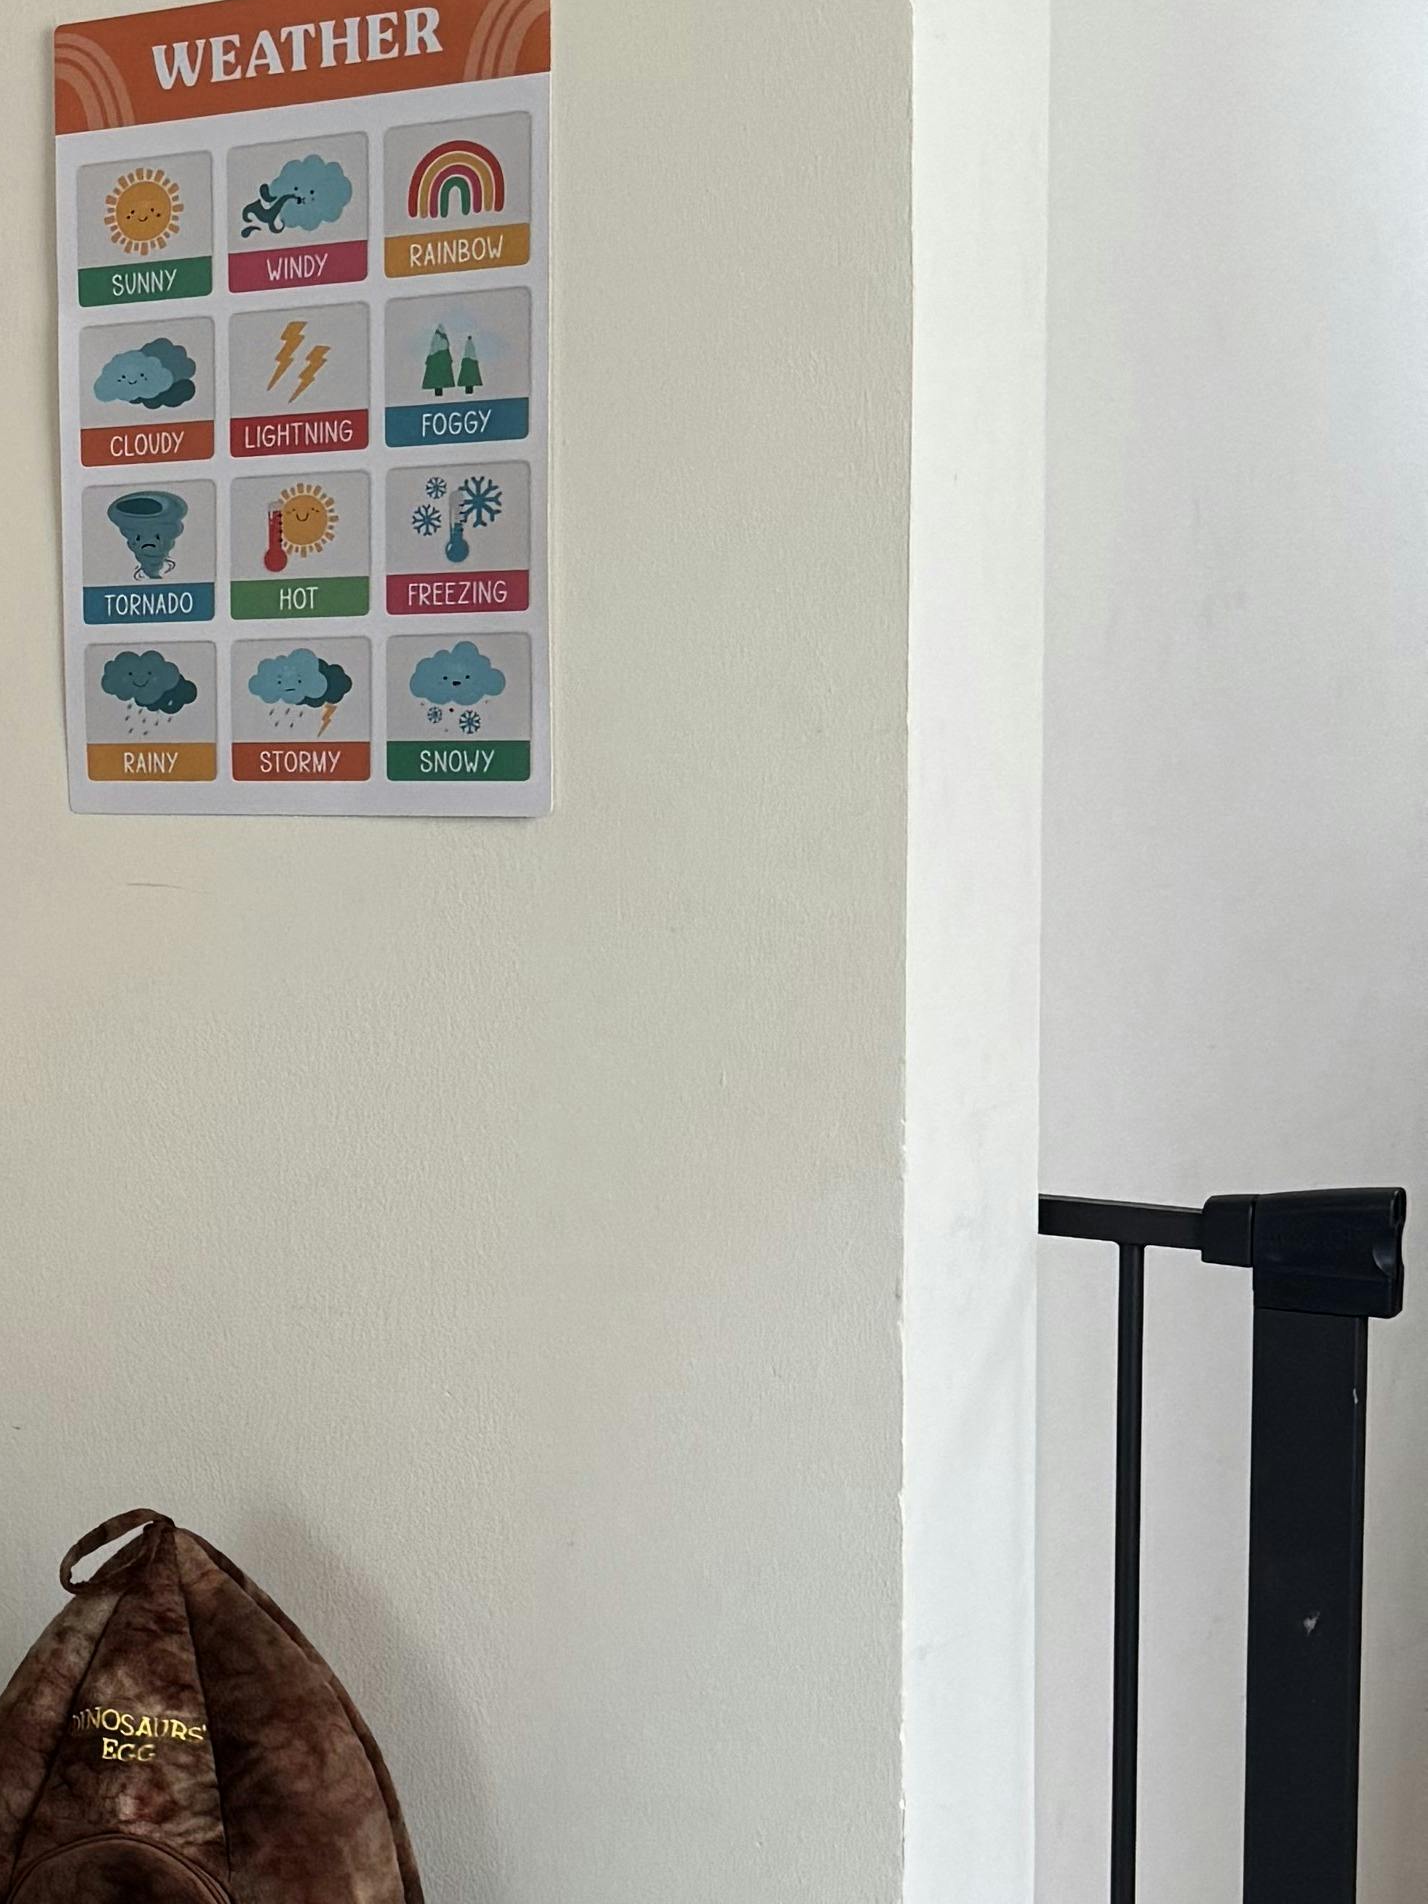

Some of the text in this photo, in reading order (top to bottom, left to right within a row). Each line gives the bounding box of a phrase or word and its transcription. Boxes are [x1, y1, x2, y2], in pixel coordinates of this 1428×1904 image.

[151, 7, 444, 90] WEATHER
[409, 234, 504, 268] RAINBOW
[266, 252, 329, 281] WINDY
[111, 268, 177, 297] SUNNY
[244, 419, 354, 449] LIGHTNING
[422, 409, 492, 438] FOGGY
[110, 430, 185, 457] CLOUDY
[104, 591, 194, 617] TORNADO
[279, 586, 319, 611] HOT
[408, 580, 508, 607] FREEZING
[123, 751, 179, 774] RAINY
[259, 750, 341, 773] STORMY
[420, 749, 495, 773] SNOWY
[101, 1736, 156, 1762] EGG
